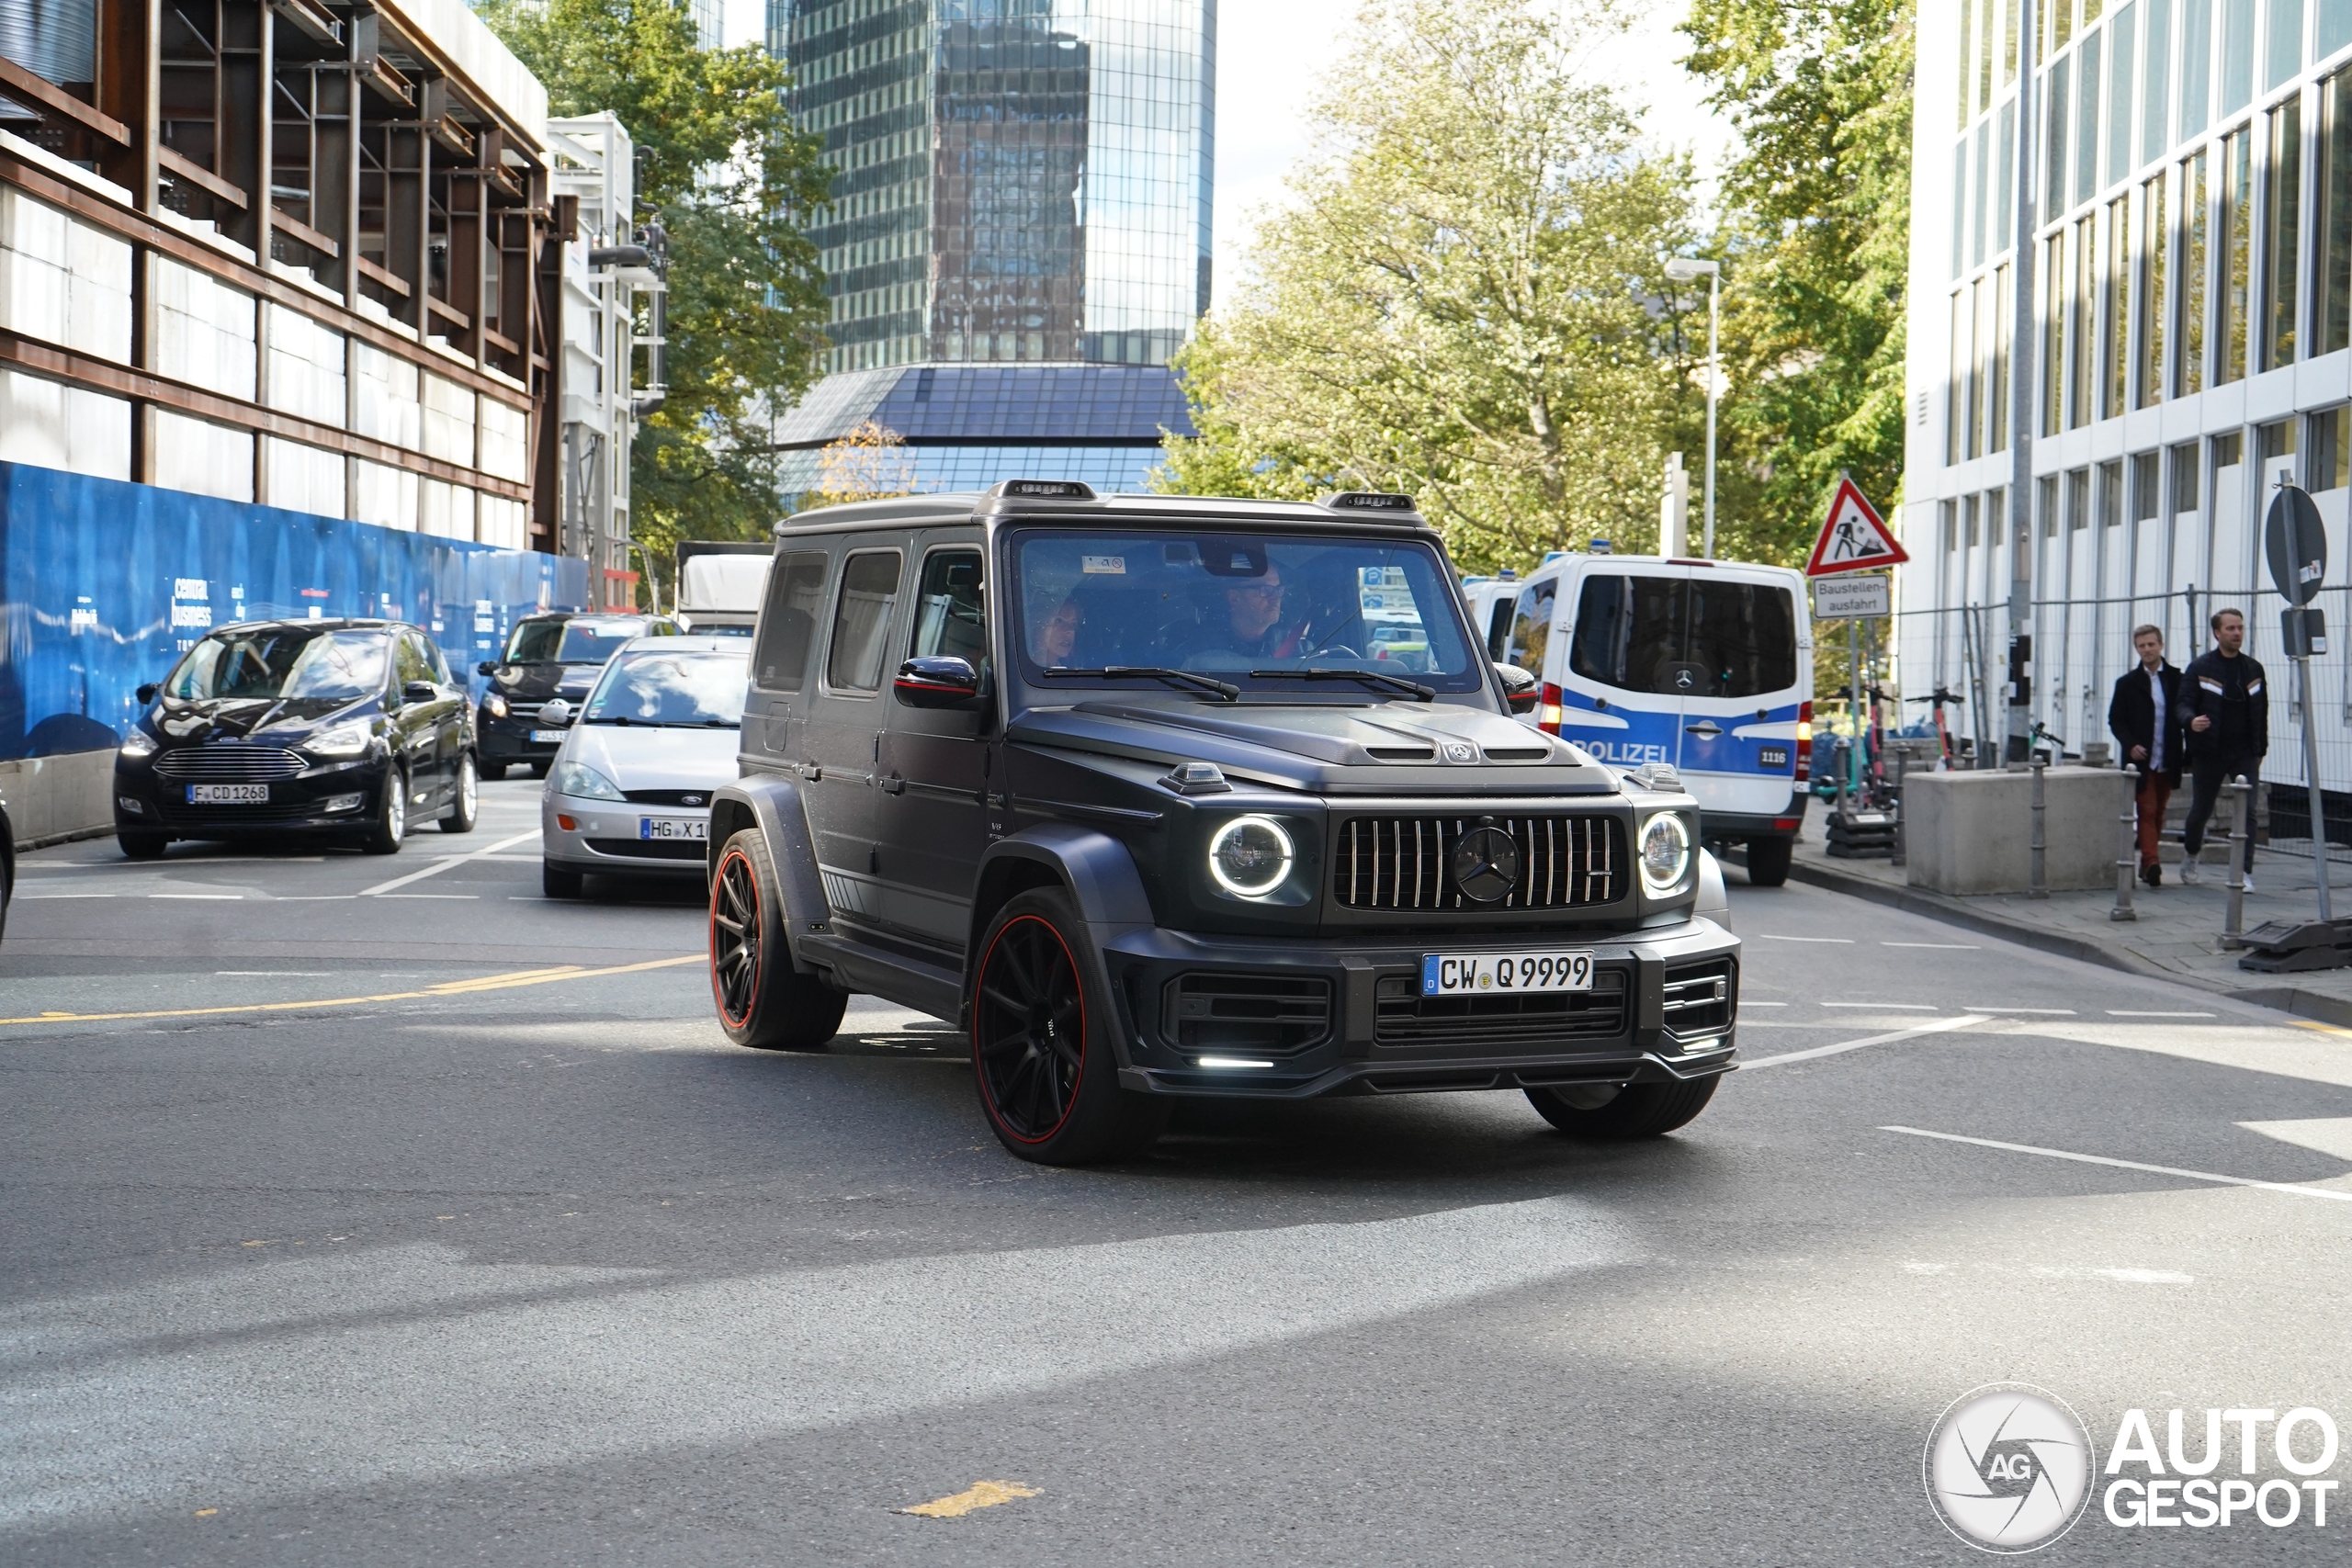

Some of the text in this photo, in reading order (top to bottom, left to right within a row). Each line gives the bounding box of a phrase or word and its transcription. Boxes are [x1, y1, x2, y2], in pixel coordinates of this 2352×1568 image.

[175, 578, 209, 600] central
[1819, 581, 1886, 595] Baustellen-
[171, 595, 212, 627] business
[1829, 599, 1877, 611] ausfahrt
[1761, 751, 1787, 763] 1116
[195, 786, 203, 799] F
[651, 821, 672, 837] HG
[1441, 959, 1477, 989] CW
[1497, 958, 1514, 987] Q
[1521, 956, 1589, 987] 9999
